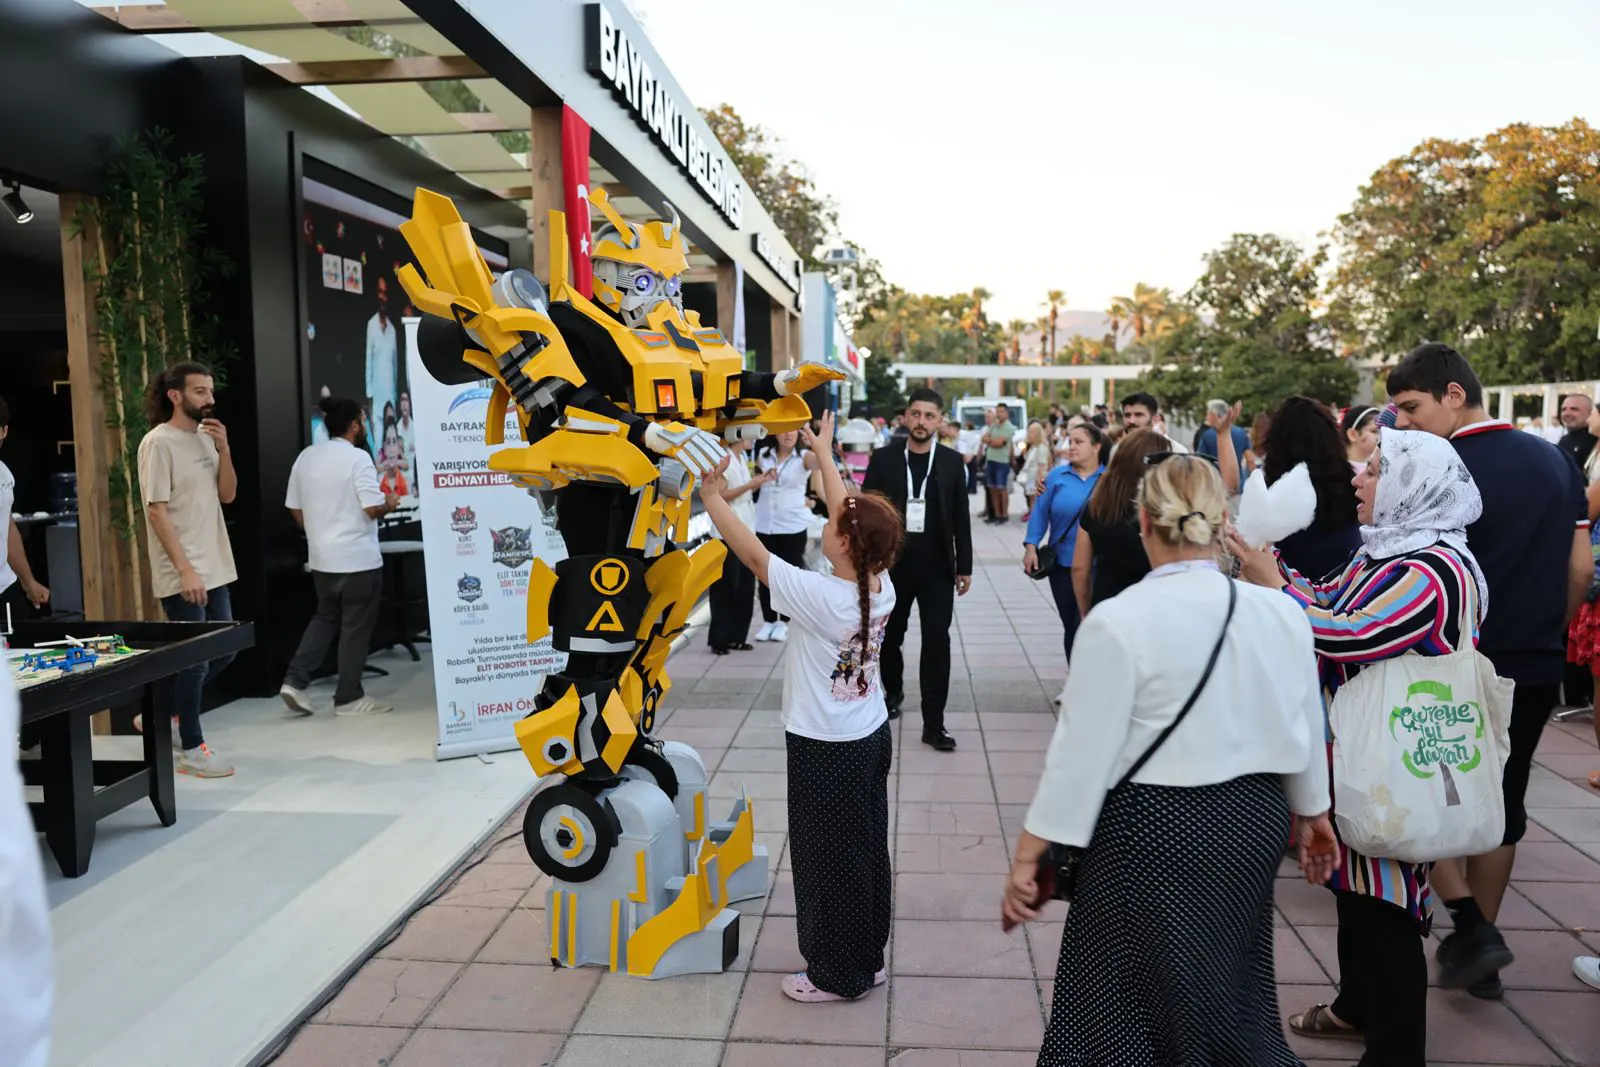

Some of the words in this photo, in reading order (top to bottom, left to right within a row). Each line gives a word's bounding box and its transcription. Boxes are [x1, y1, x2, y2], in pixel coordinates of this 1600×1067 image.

[599, 3, 688, 168] BAYRAKLI
[440, 421, 486, 431] BAYRAK
[452, 434, 483, 443] TEKNO
[432, 459, 488, 472] YARIŞIYOR
[438, 474, 487, 487] DÜNYAYI
[474, 635, 493, 645] Yılda
[495, 635, 505, 643] bir
[506, 633, 519, 642] kez
[468, 644, 511, 655] uluslararası
[513, 640, 552, 651] standartla
[447, 656, 476, 667] Robotik
[477, 663, 492, 673] ELİT
[493, 660, 528, 670] ROBOTİK
[529, 657, 554, 667] TAKIMI
[455, 673, 494, 685] Bayraklı'yı
[495, 670, 529, 682] dünyada
[530, 666, 552, 676] temsil
[477, 701, 513, 716] İRFAN
[516, 697, 533, 711] ÖN
